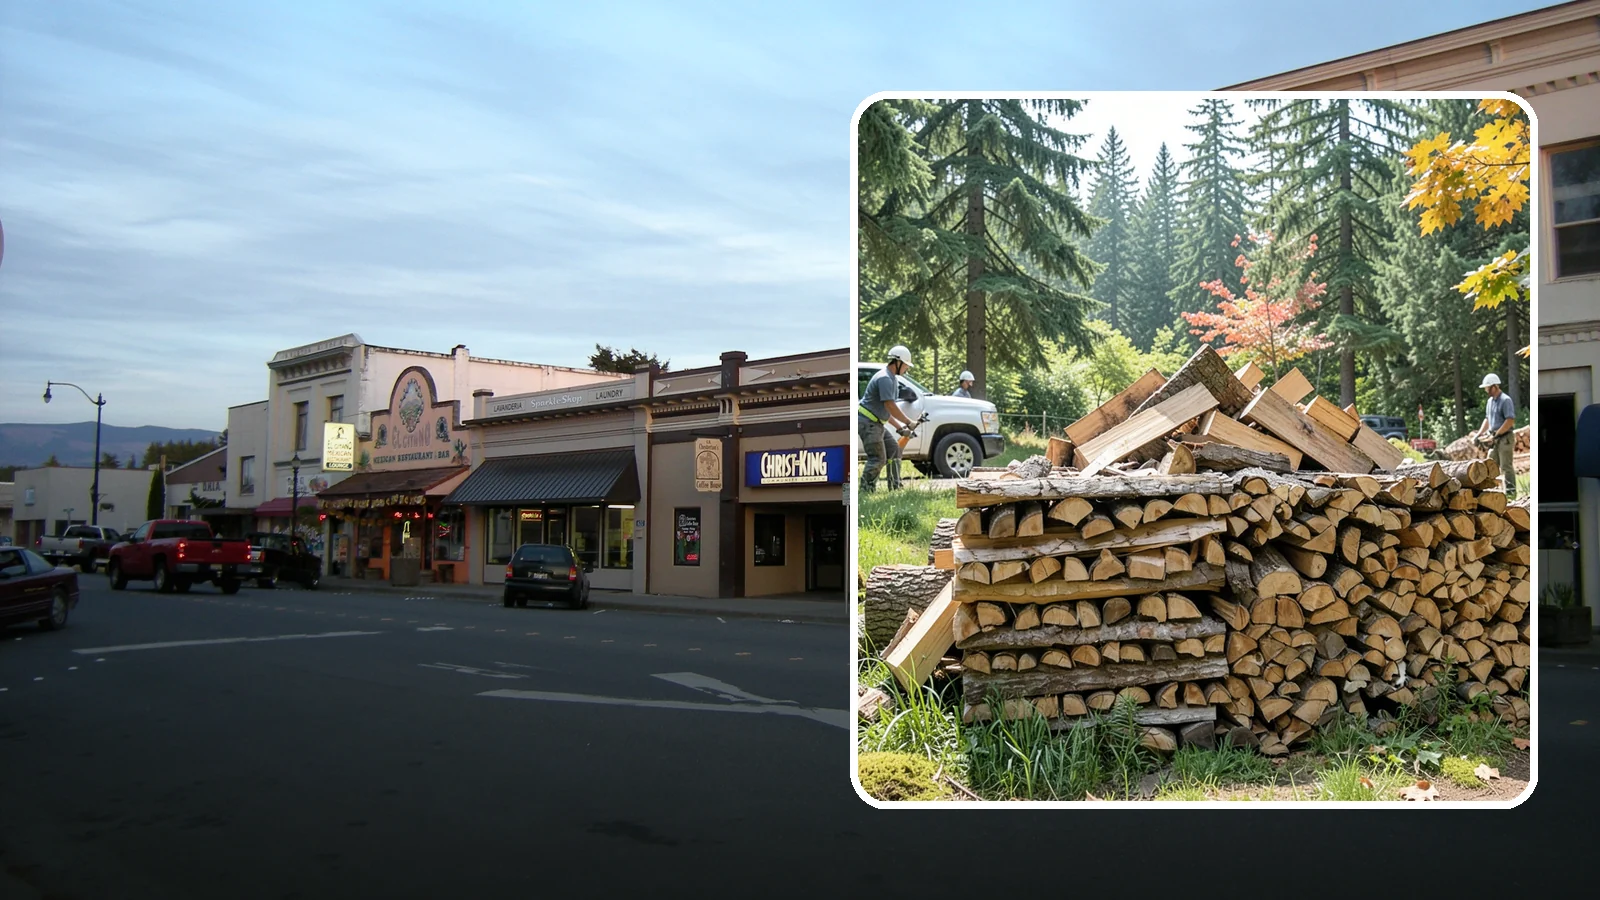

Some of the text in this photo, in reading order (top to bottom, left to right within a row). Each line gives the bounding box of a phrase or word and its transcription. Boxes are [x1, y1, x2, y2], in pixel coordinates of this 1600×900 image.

[493, 389, 624, 412] LAVANDERIA Sparkle Shop LAUNDRY
[373, 455, 396, 464] MEXICAN
[398, 451, 433, 462] RESTAURANT
[438, 450, 450, 459] BAR
[761, 450, 827, 477] CHRIST KING
[697, 480, 709, 489] Coffee
